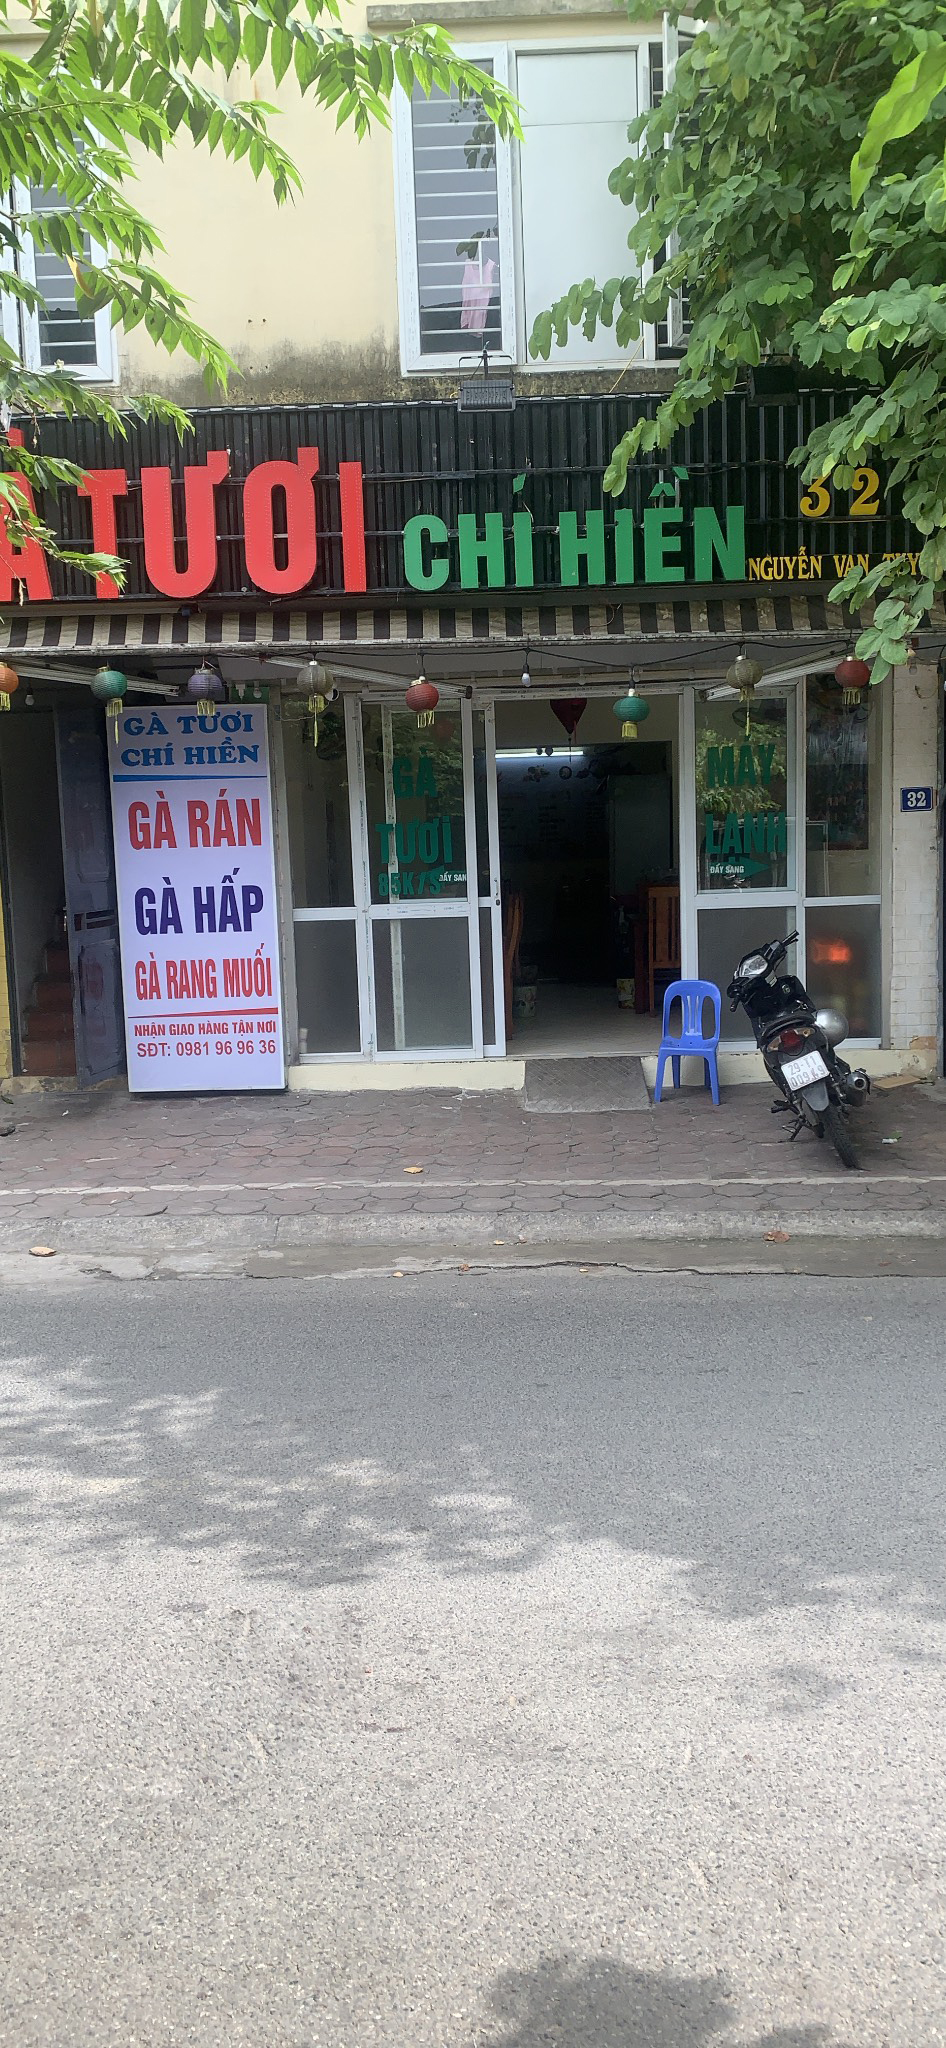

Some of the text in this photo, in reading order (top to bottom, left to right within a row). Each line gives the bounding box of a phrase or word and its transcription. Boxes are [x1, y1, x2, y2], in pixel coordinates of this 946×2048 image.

[800, 467, 880, 517] 32
[77, 446, 367, 598] TƯƠI
[403, 473, 534, 591] CHÍ
[558, 466, 746, 587] HIỀN
[748, 545, 822, 581] NGUYỄN
[123, 711, 254, 736] GÀ TƯƠI
[120, 736, 260, 767] CHÍ HIỀN
[907, 791, 927, 807] 32
[127, 788, 263, 850] GÀ RÁN
[725, 865, 745, 874] SANG
[134, 867, 264, 935] GÀ HẤP
[135, 943, 272, 1000] GÀ RANG MUỐI
[134, 1019, 277, 1039] NHẬN GIAO HÀNG TẬN NƠI
[137, 1039, 276, 1057] SĐT: 0981 96 96 36
